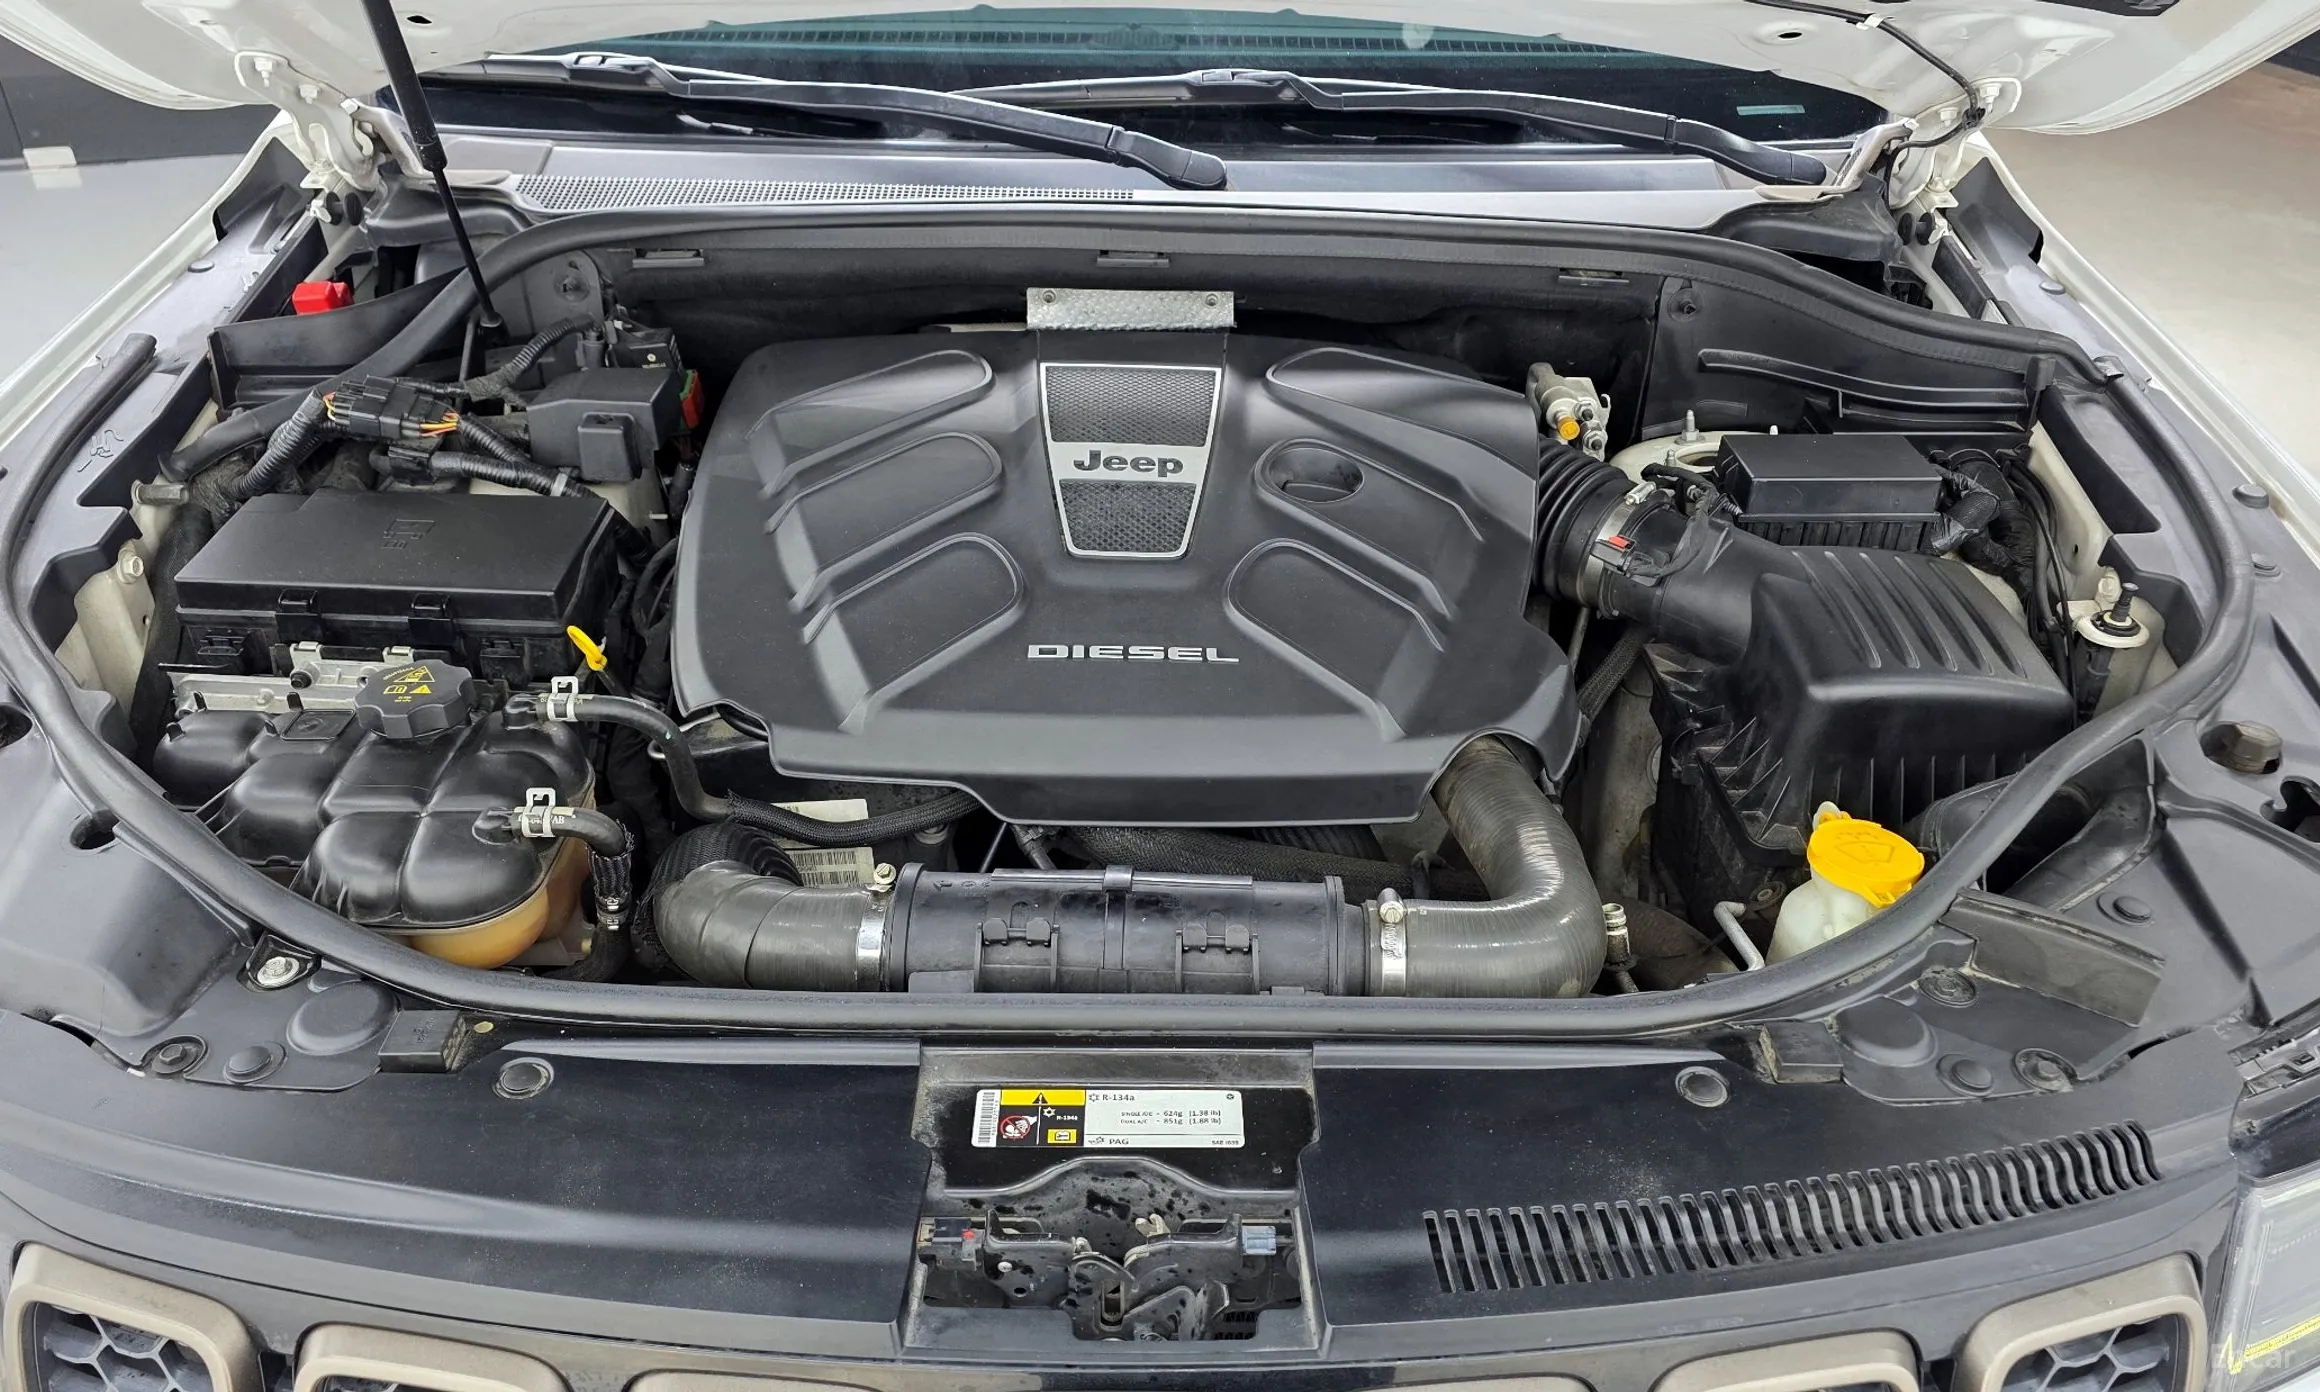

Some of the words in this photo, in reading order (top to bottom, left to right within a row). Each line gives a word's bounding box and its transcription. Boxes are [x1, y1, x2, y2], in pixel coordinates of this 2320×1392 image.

[1074, 450, 1184, 477] Jeep
[1027, 644, 1240, 663] DIESEL
[1163, 1110, 1183, 1118] 624g
